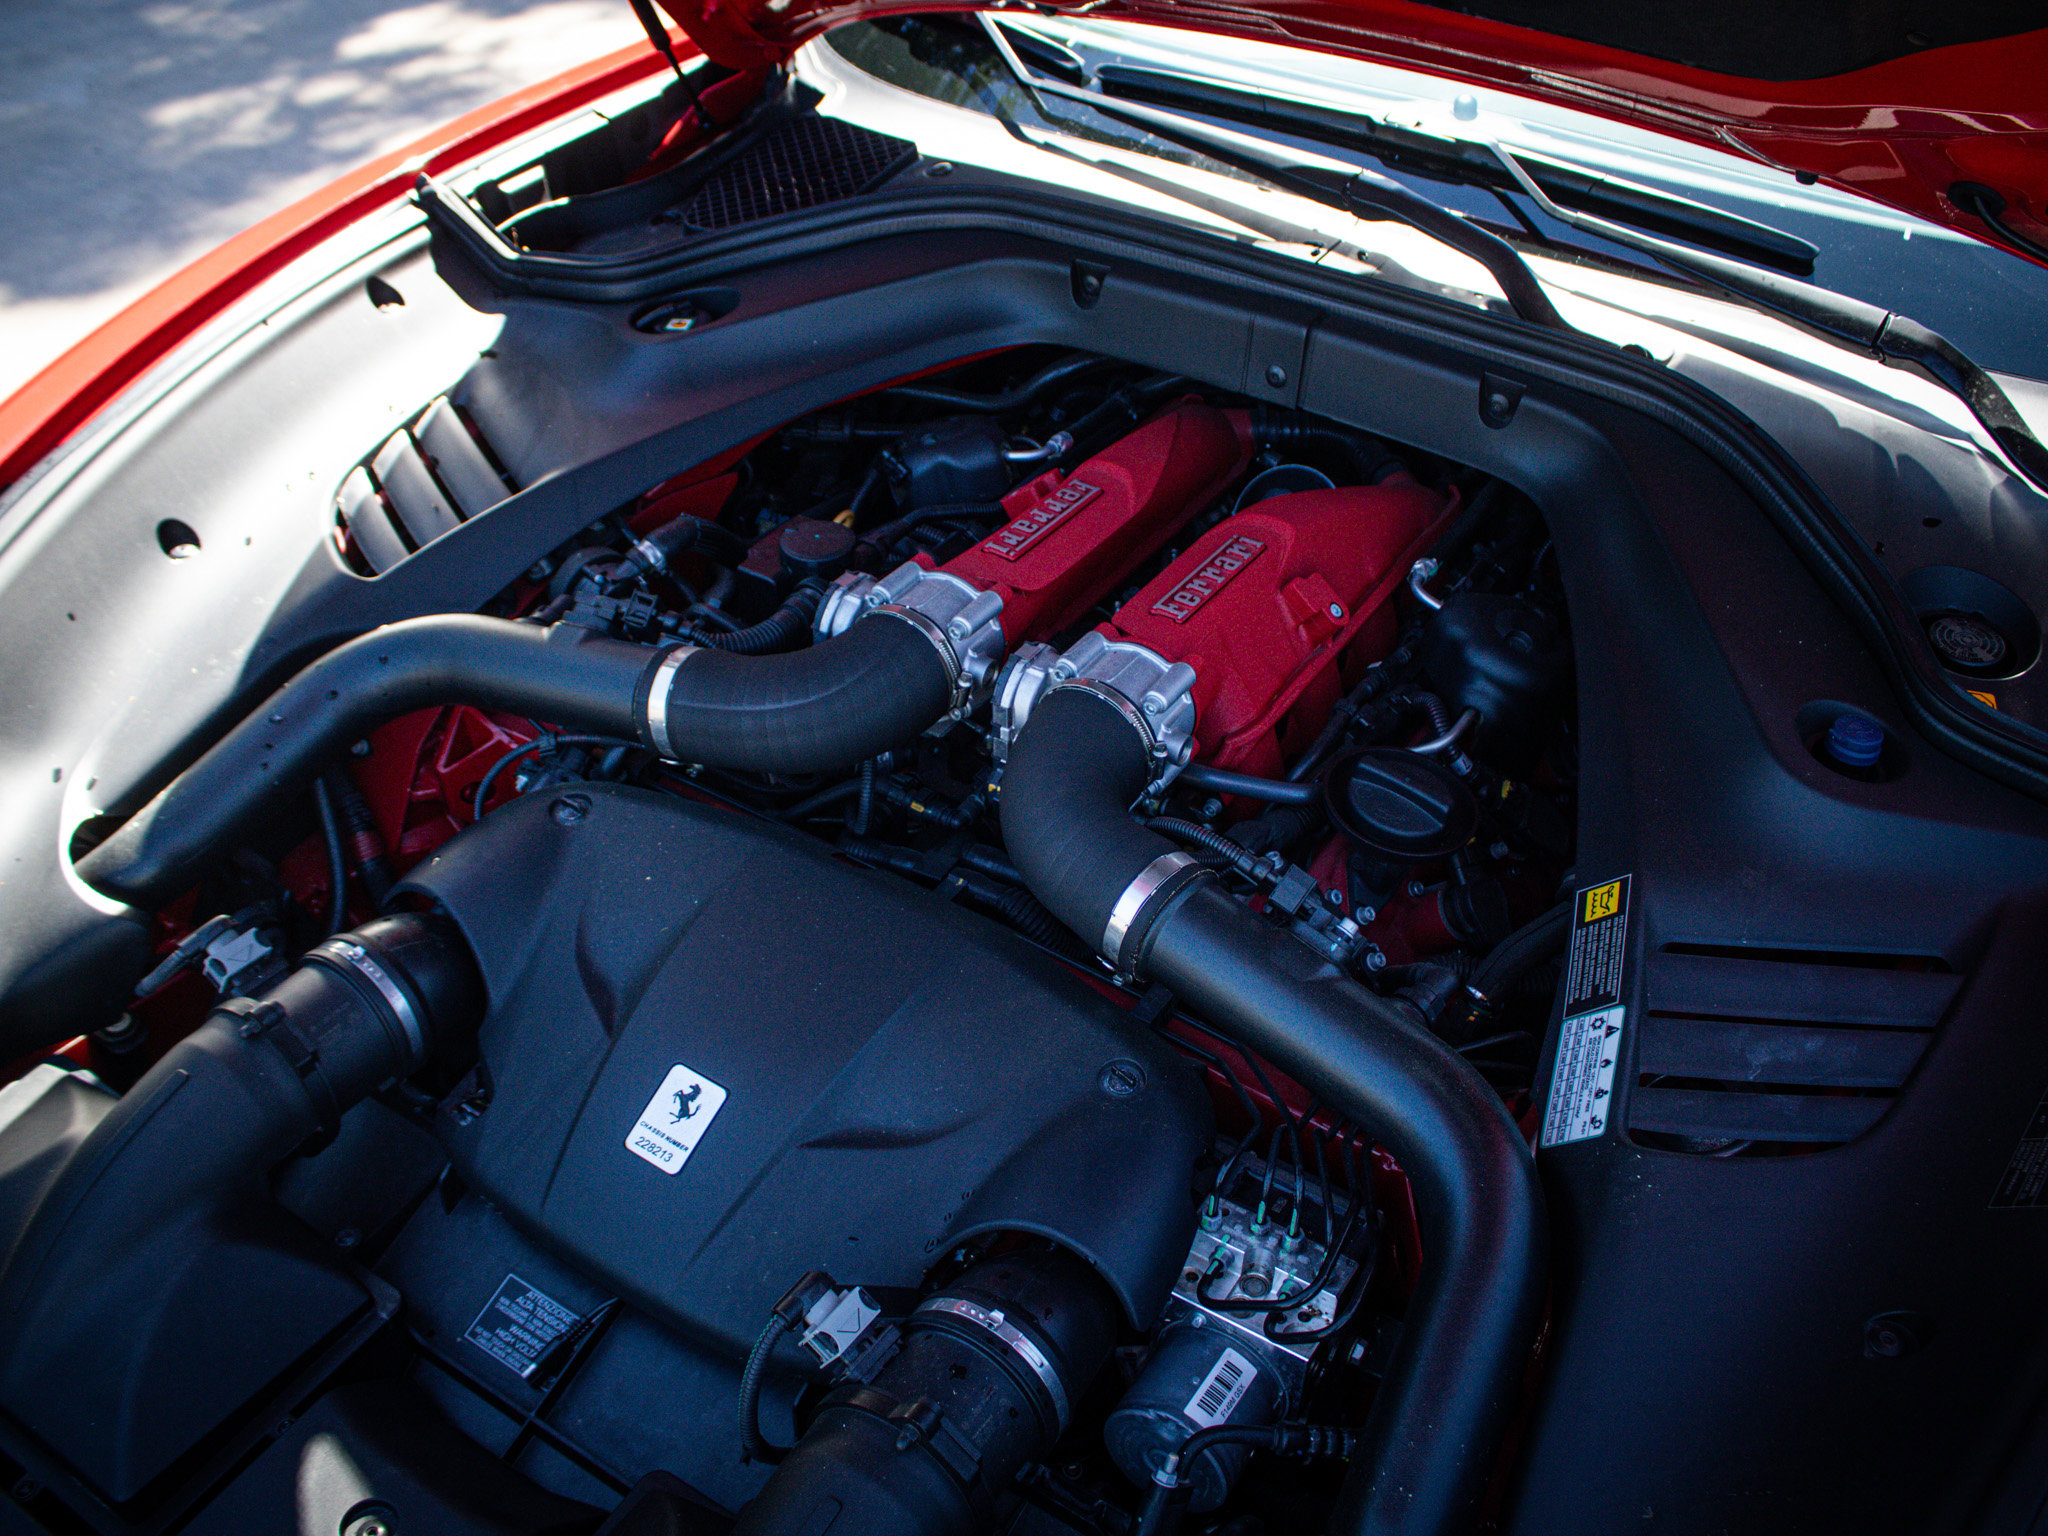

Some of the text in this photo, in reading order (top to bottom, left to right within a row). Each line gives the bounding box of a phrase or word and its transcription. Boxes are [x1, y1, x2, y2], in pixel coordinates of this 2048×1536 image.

[985, 478, 1101, 556] Ferrari
[1152, 534, 1266, 621] Ferrari
[634, 1136, 674, 1163] 228213
[640, 1120, 690, 1153] CHASSIS NUMBER
[514, 1294, 536, 1311] ALTA
[524, 1289, 574, 1325] ATTENZIONE
